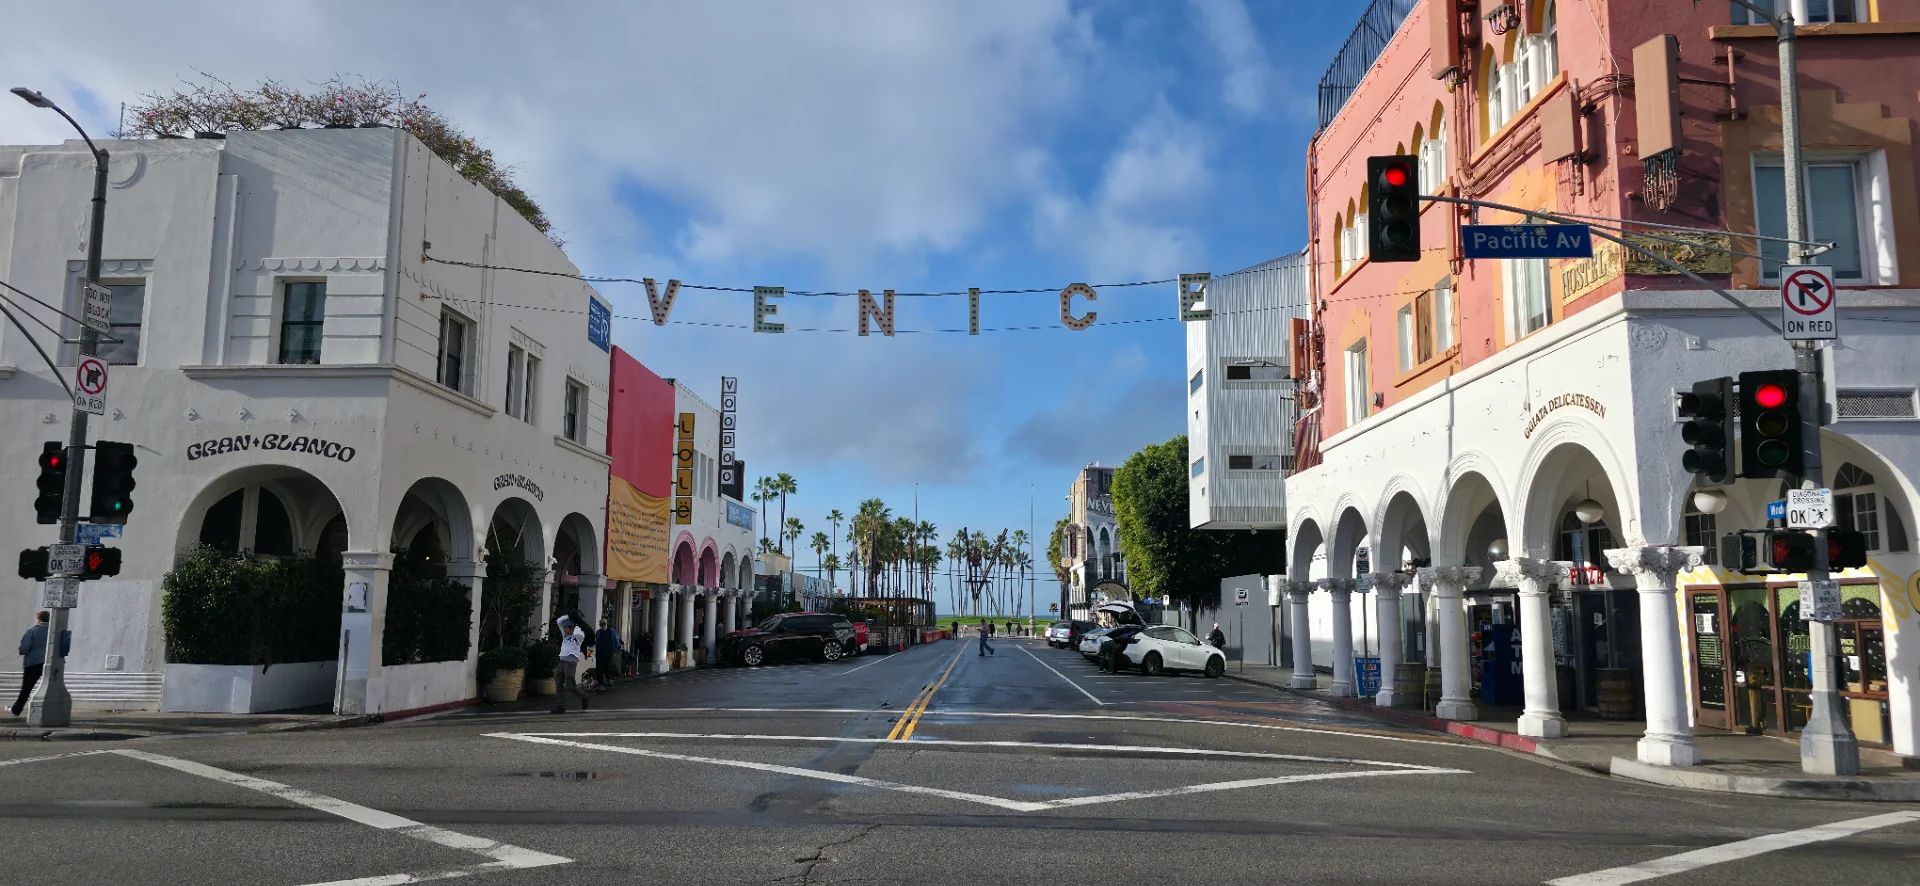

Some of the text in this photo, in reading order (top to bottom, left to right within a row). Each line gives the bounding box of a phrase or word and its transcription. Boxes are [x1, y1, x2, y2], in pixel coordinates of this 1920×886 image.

[1473, 231, 1581, 249] Pacific Av
[1562, 250, 1607, 299] HOSTEL
[643, 272, 1213, 337] VENICE
[1788, 320, 1833, 332] ON RED
[77, 396, 102, 409] ON RED
[1524, 393, 1606, 439] GGIATA DELICATESSEN
[722, 380, 734, 482] VOODOO
[187, 433, 356, 462] GRAN BLANCO
[494, 473, 544, 502] GRAN BLANCO
[1793, 490, 1824, 498] DIAGONAL
[1790, 509, 1806, 524] OK
[51, 559, 63, 570] OK
